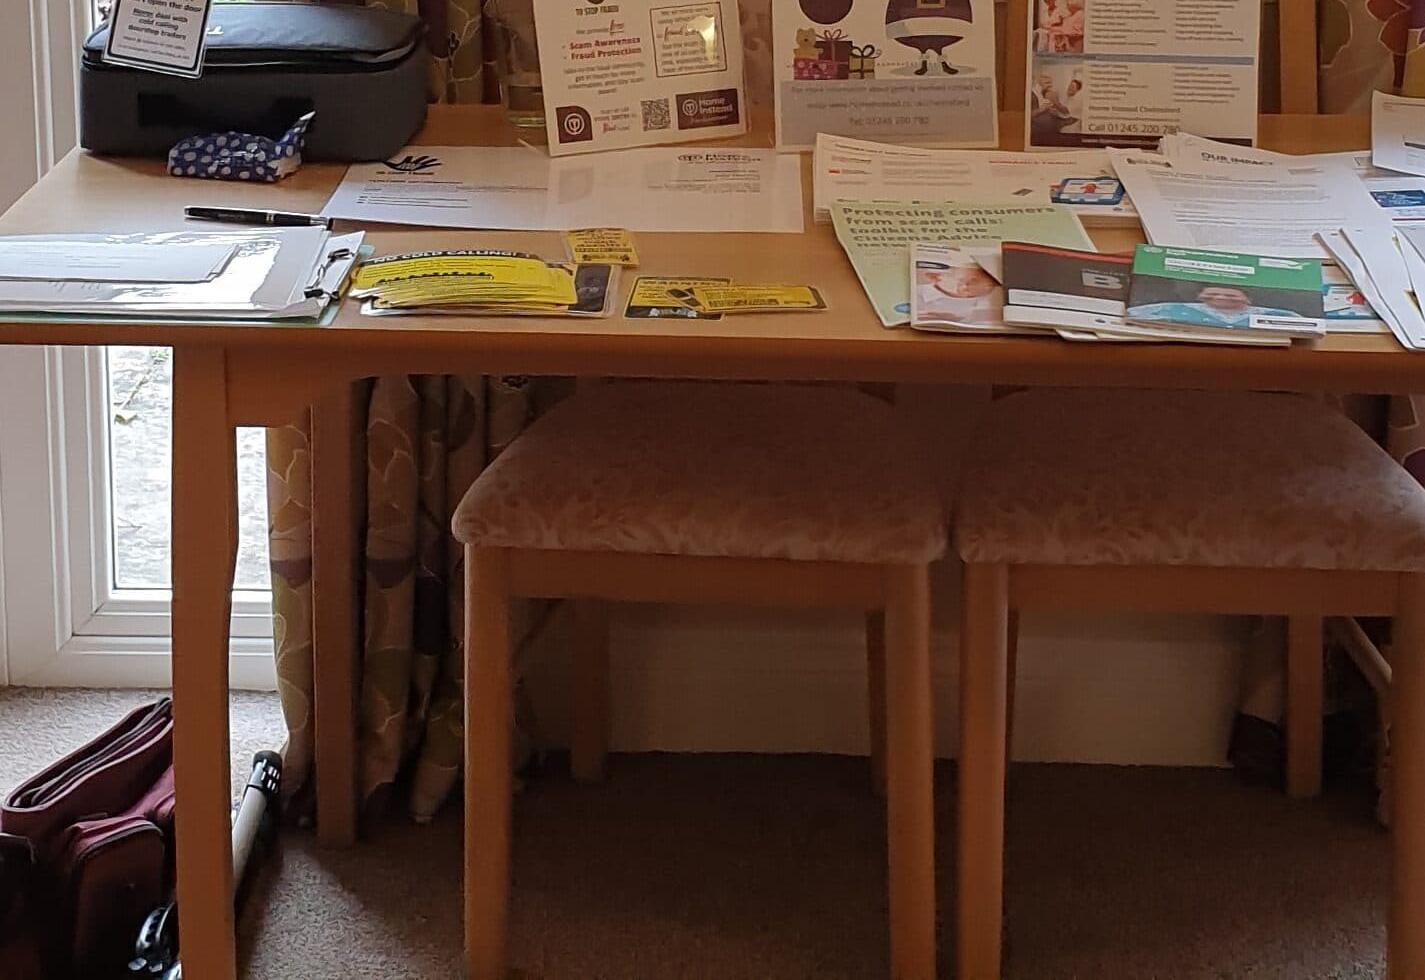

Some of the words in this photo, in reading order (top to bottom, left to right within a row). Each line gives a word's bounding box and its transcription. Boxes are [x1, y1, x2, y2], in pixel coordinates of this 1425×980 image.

[169, 0, 182, 8] the
[155, 11, 171, 19] deal
[128, 24, 159, 35] doorstep
[155, 20, 179, 30] calling
[594, 37, 640, 47] Awareness
[597, 47, 642, 58] Protection
[699, 97, 725, 106] Home
[699, 104, 733, 114] Instead
[1088, 123, 1106, 132] Call
[1107, 123, 1138, 132] 01245
[1201, 152, 1227, 162] OUR
[843, 207, 943, 218] Protecting
[949, 206, 1056, 216] consumers
[847, 217, 892, 226] from
[954, 217, 1004, 226] calls:
[402, 251, 442, 259] COLD
